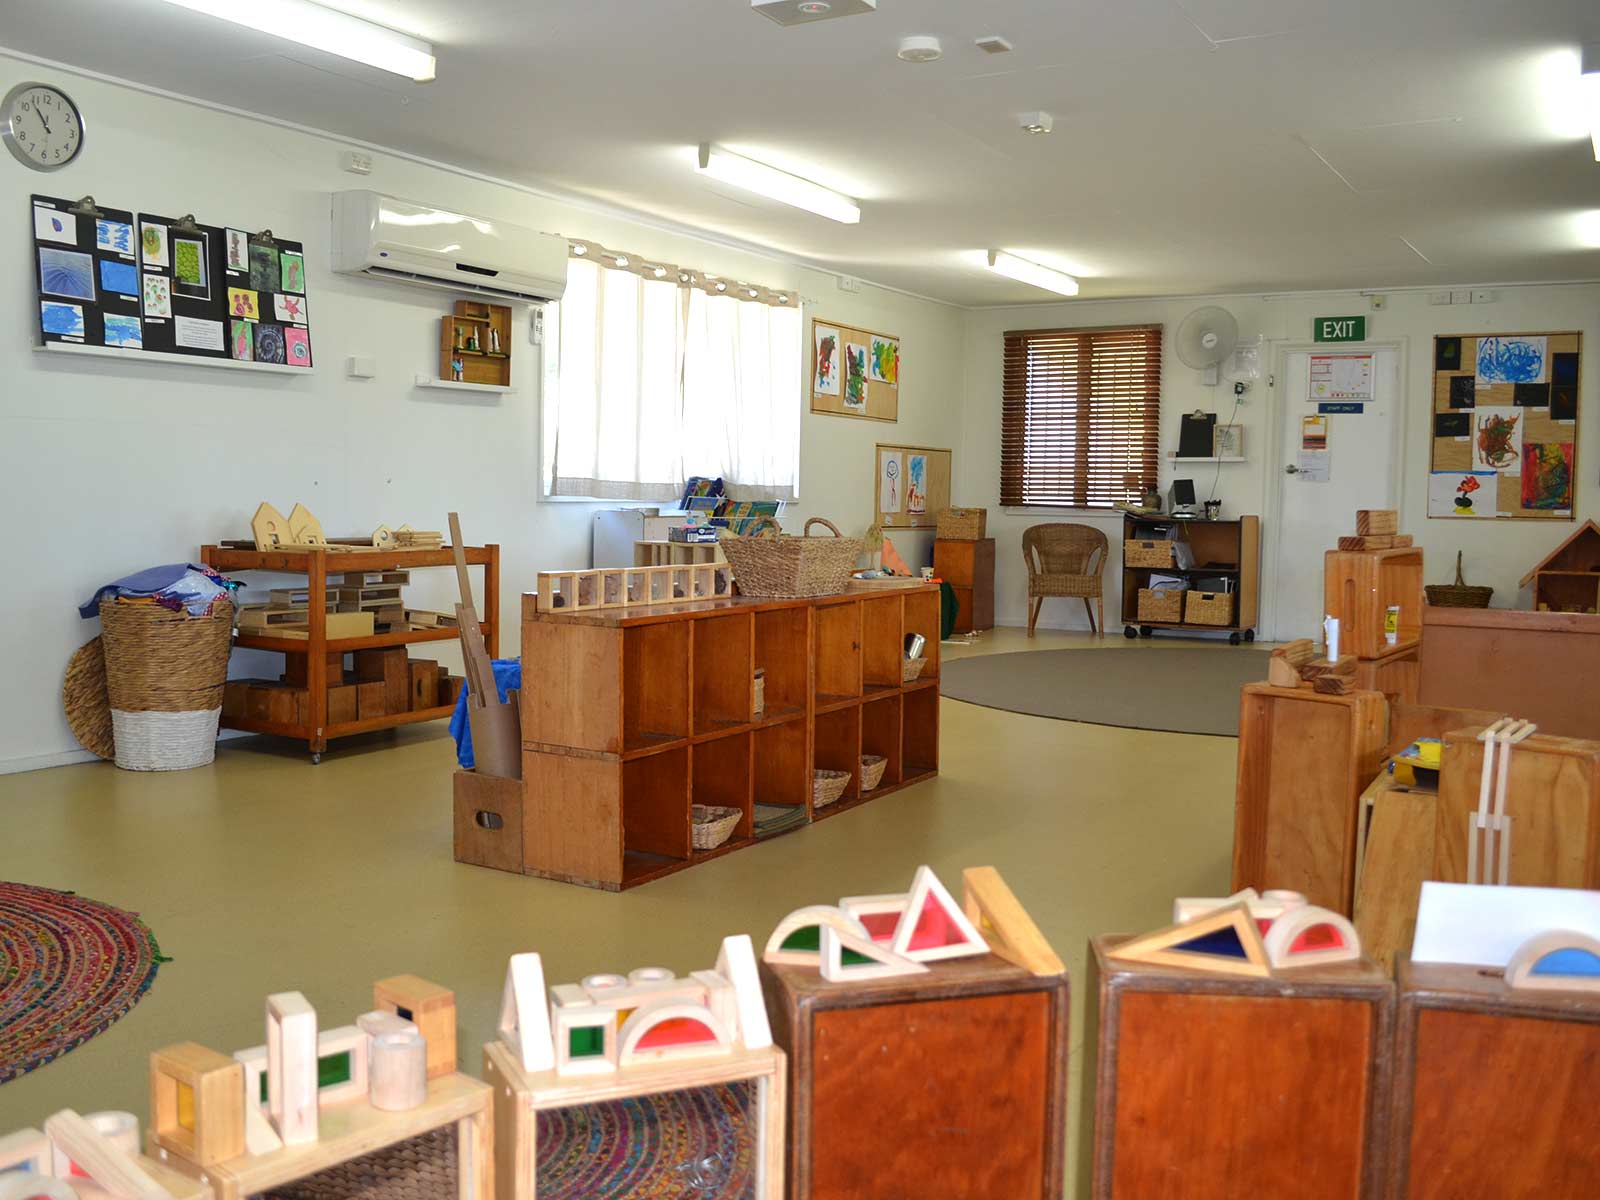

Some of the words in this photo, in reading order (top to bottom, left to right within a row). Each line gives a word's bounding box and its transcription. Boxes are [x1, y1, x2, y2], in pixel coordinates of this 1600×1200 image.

[32, 95, 40, 104] 11
[43, 94, 52, 104] 12
[22, 102, 30, 112] 10
[58, 102, 60, 110] 1
[16, 116, 21, 124] 9
[65, 113, 70, 123] 2
[20, 131, 25, 140] 8
[70, 130, 74, 139] 3
[30, 142, 35, 152] 7
[64, 143, 69, 152] 4
[41, 150, 47, 159] 6
[55, 149, 60, 158] 5
[1323, 320, 1356, 338] EXIT
